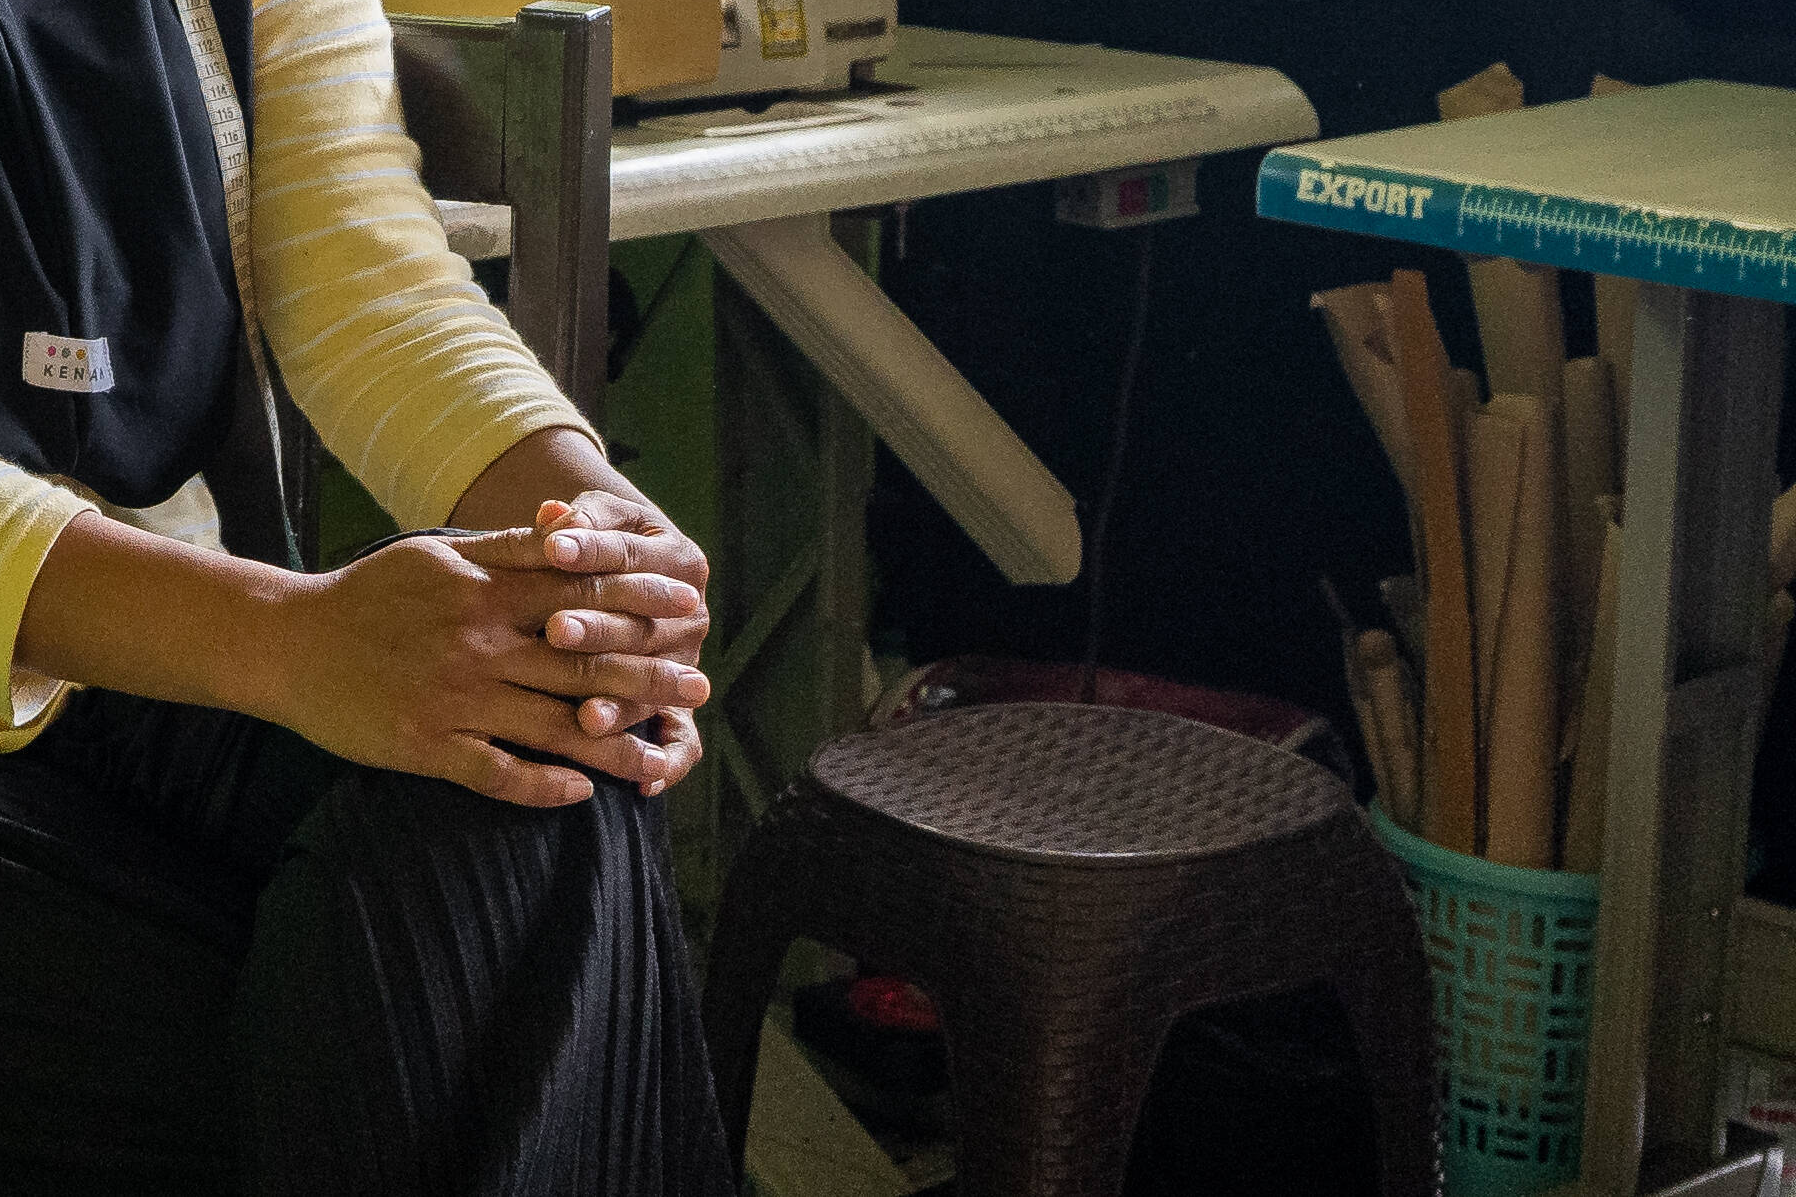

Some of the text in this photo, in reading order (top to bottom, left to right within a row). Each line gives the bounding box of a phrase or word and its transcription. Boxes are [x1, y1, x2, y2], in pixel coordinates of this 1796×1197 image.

[191, 17, 207, 30] 111
[198, 39, 213, 53] 112
[205, 62, 220, 76] 113
[211, 84, 227, 98] 114
[218, 107, 234, 122] 115
[222, 130, 239, 144] 116
[227, 152, 242, 167] 117
[1296, 168, 1434, 220] EXPORT
